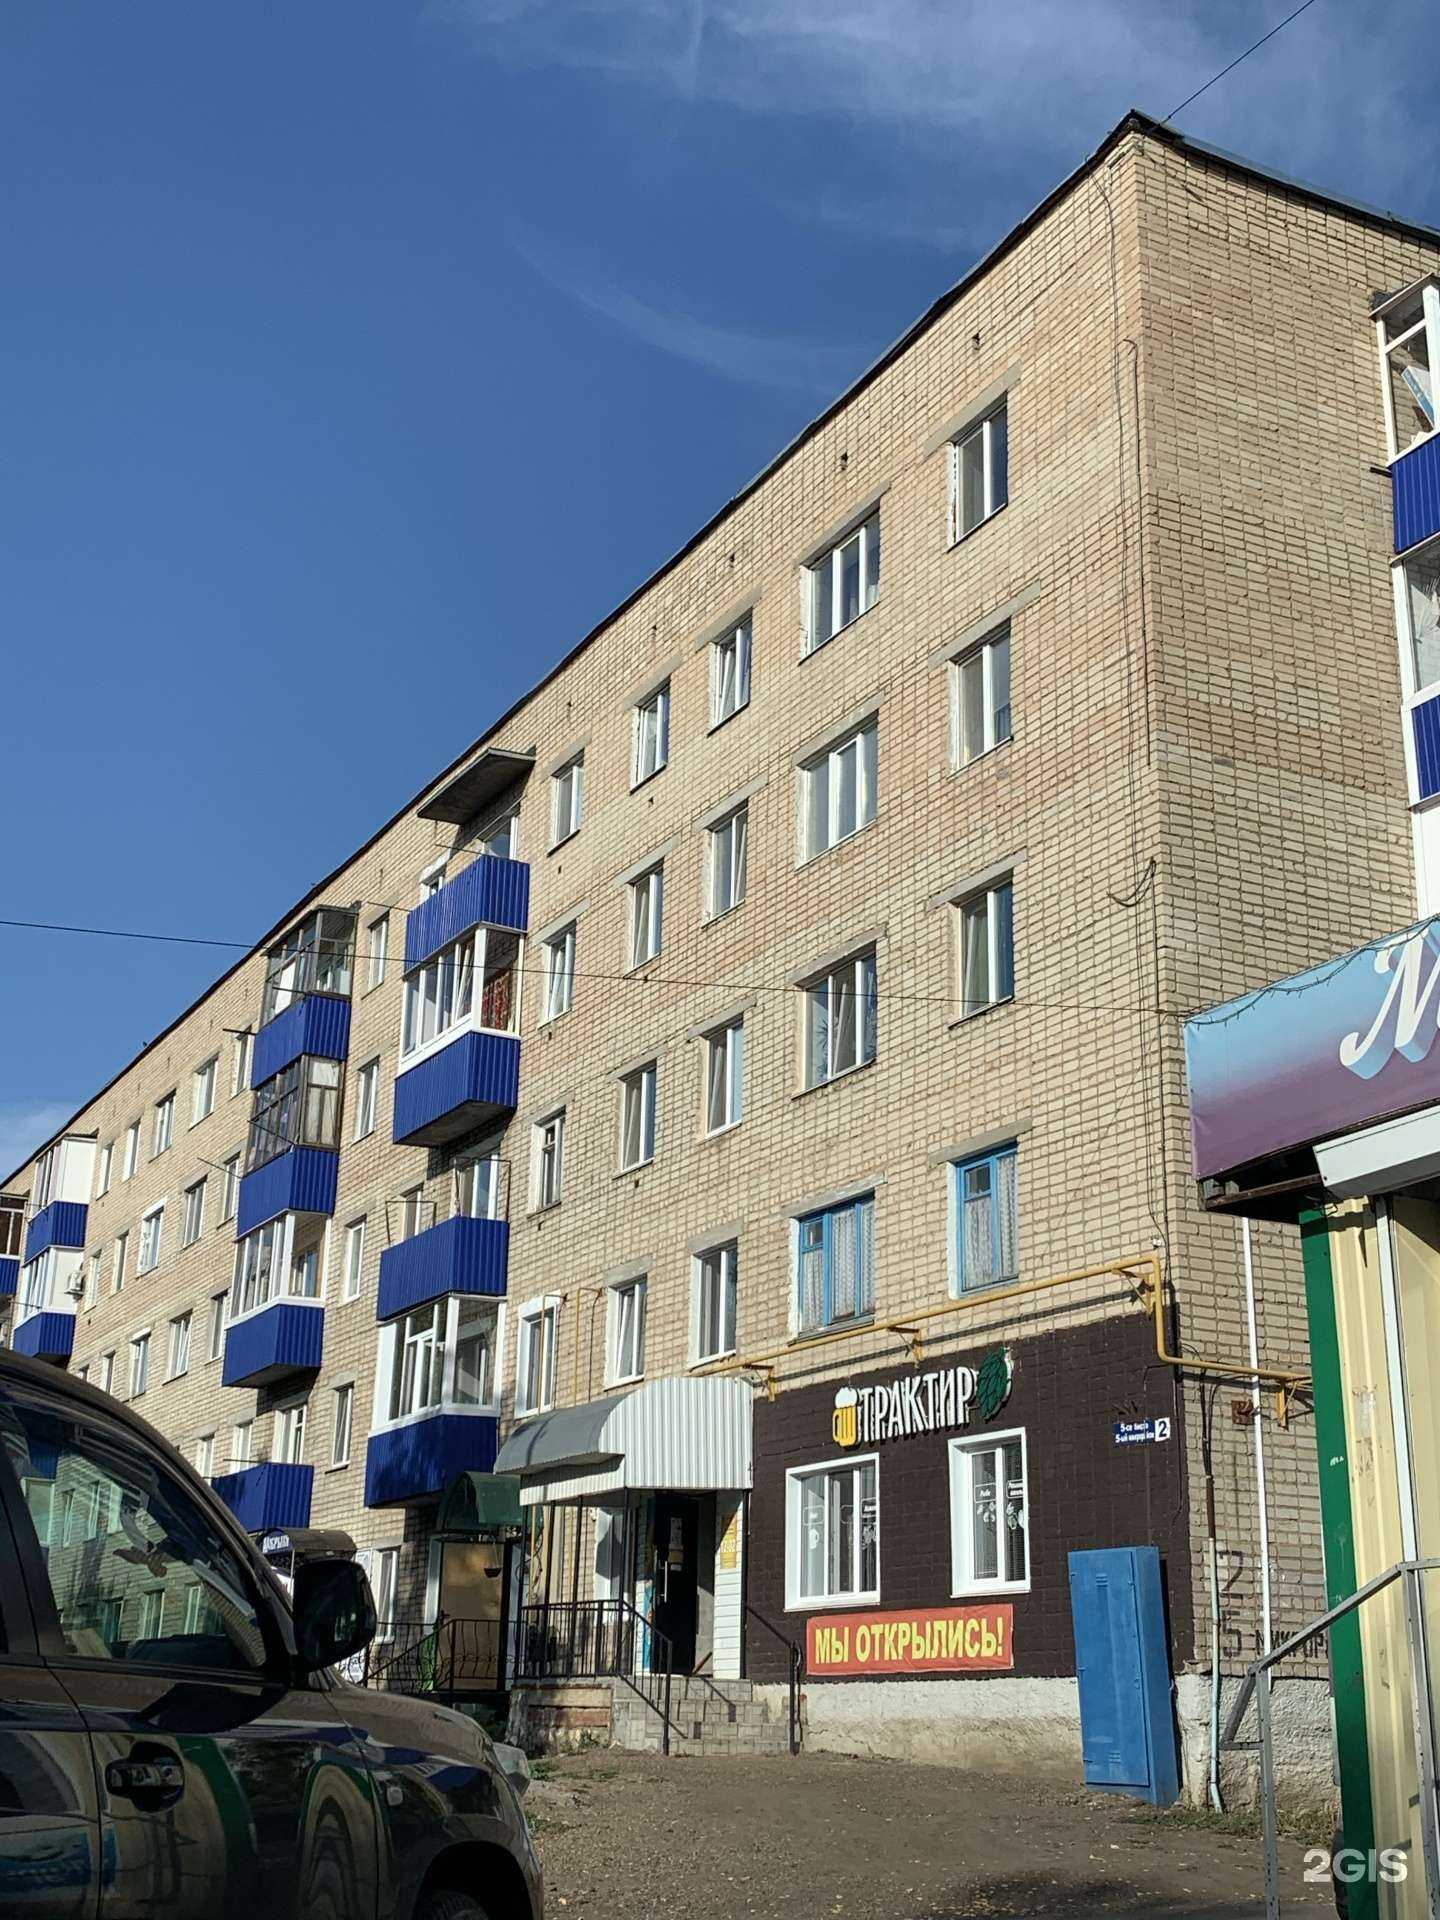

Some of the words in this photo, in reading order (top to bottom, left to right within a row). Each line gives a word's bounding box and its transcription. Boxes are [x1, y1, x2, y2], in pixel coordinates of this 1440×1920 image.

[860, 1367, 975, 1442] ТРАКТИР
[1158, 1420, 1167, 1438] 2
[1217, 1551, 1243, 1599] 2
[814, 1629, 849, 1664] МЫ
[856, 1616, 1004, 1662] ОТКРЫЛИСЬ!
[1222, 1610, 1241, 1657] 5
